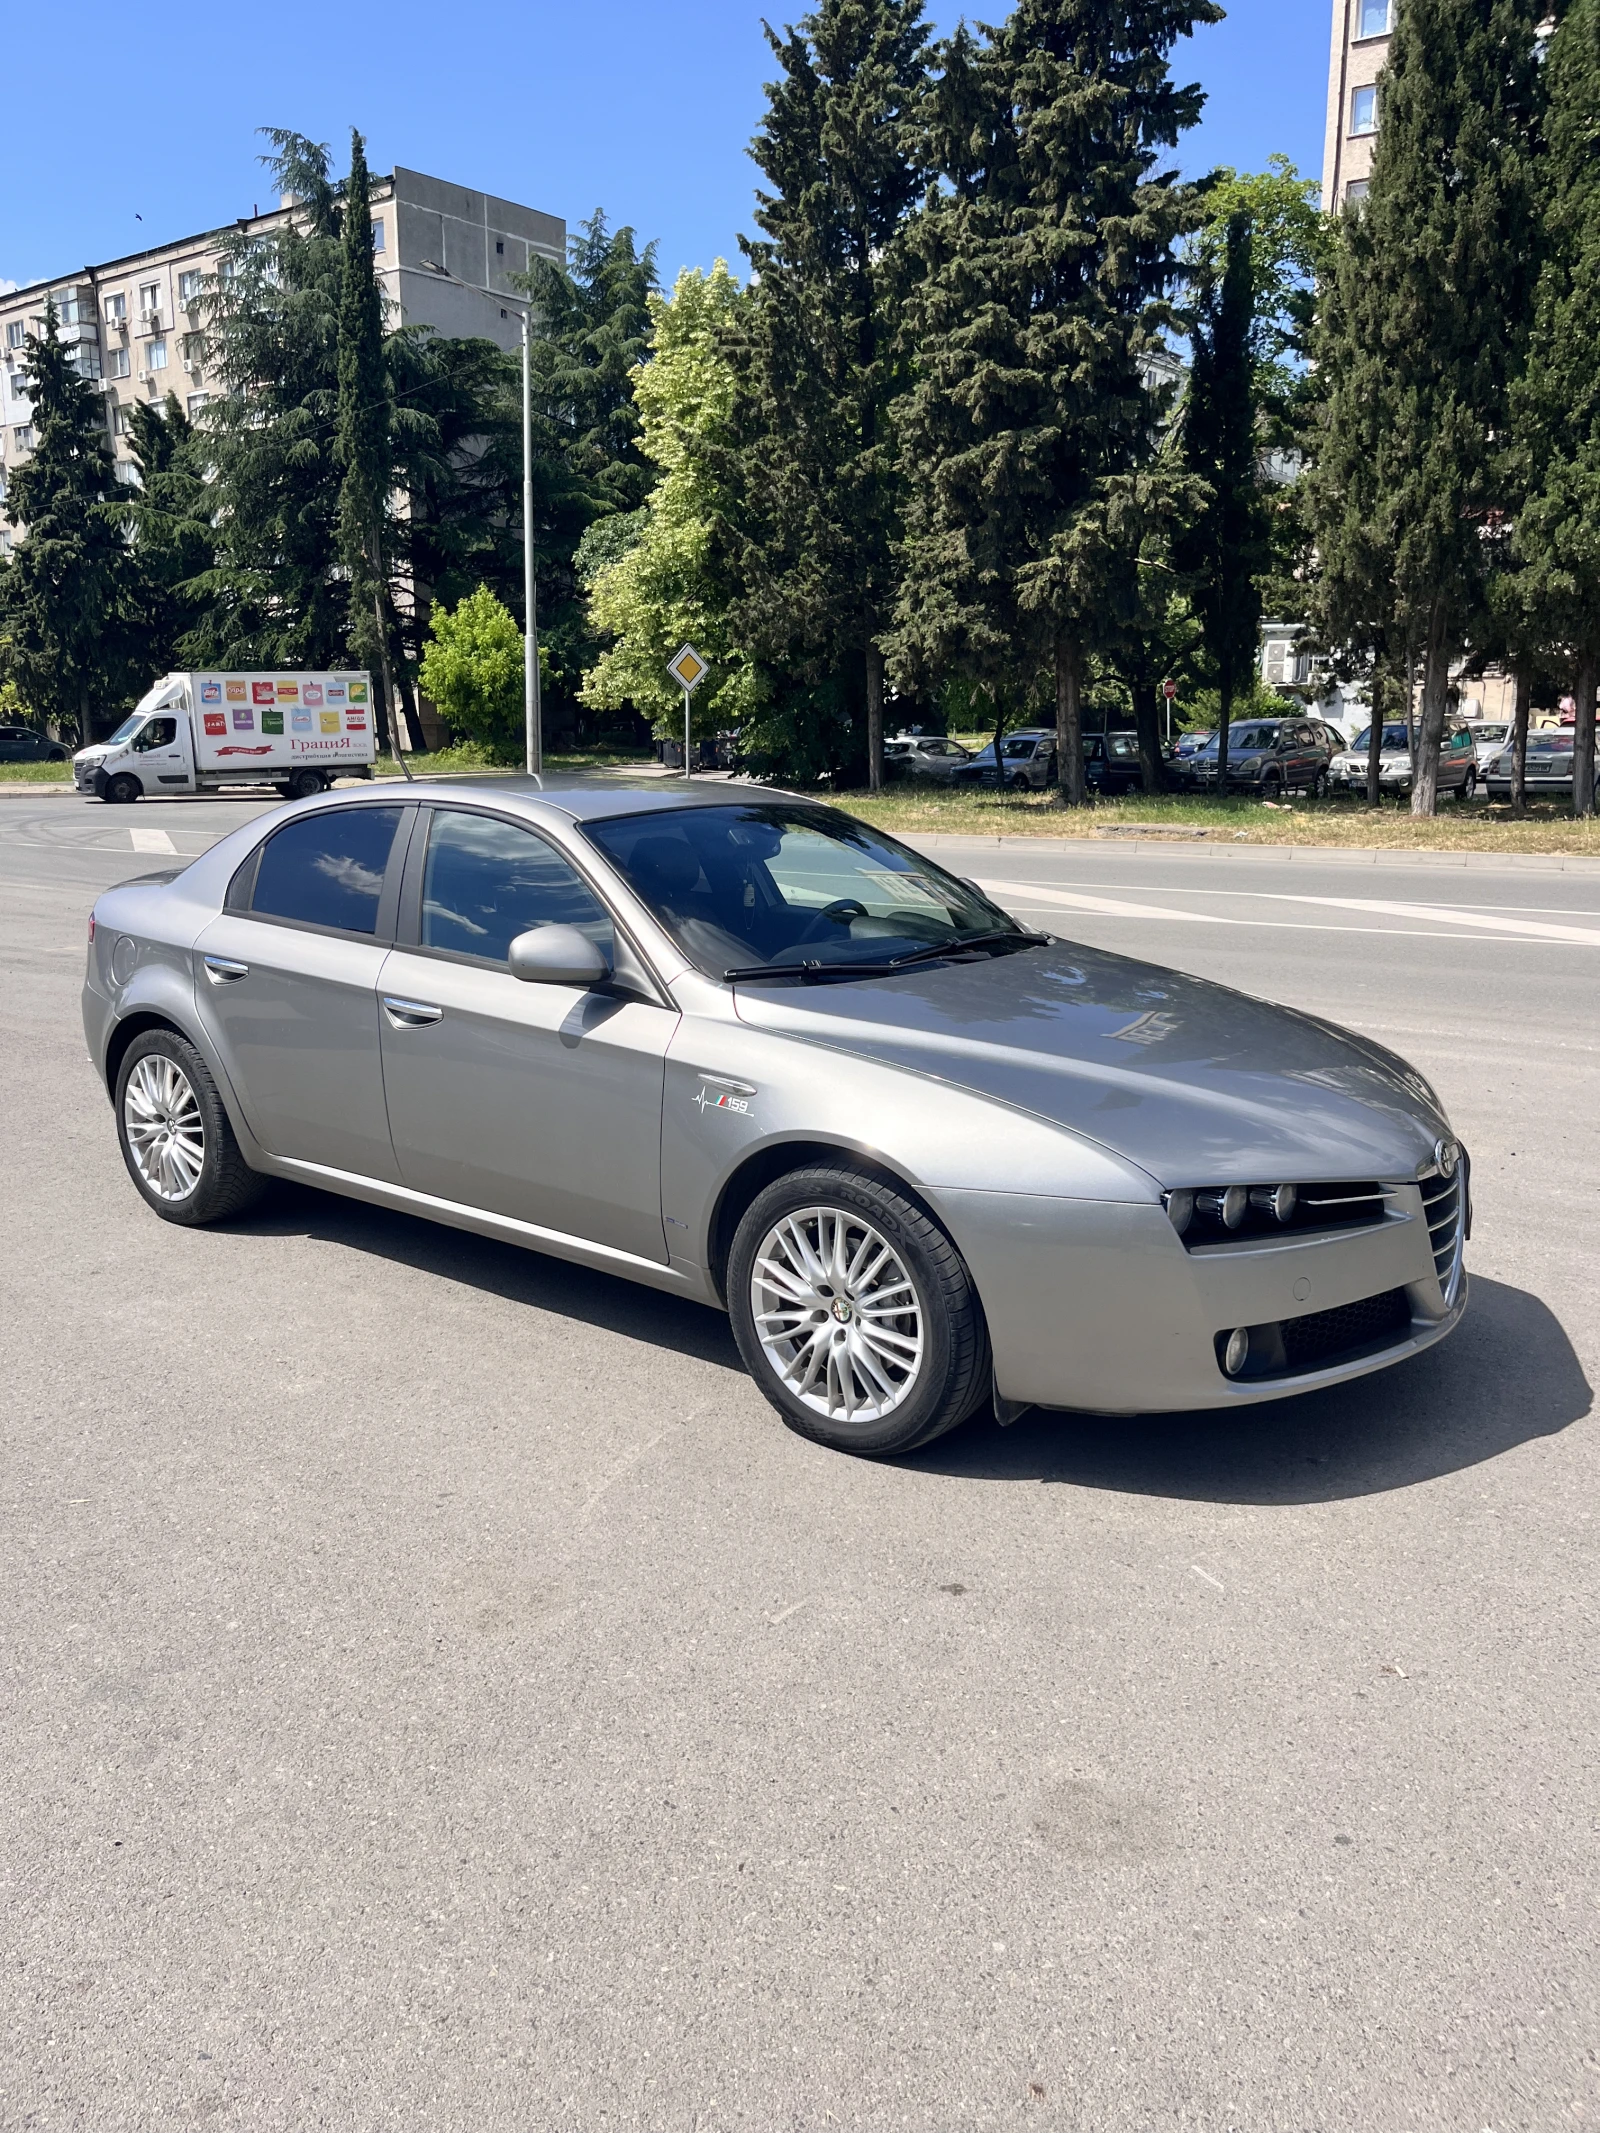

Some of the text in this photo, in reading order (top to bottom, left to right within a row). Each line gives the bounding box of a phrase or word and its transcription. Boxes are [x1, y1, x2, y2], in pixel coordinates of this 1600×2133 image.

[290, 737, 350, 752] ГрациЯ
[727, 1096, 749, 1112] 159
[840, 1187, 916, 1249] ROADX
